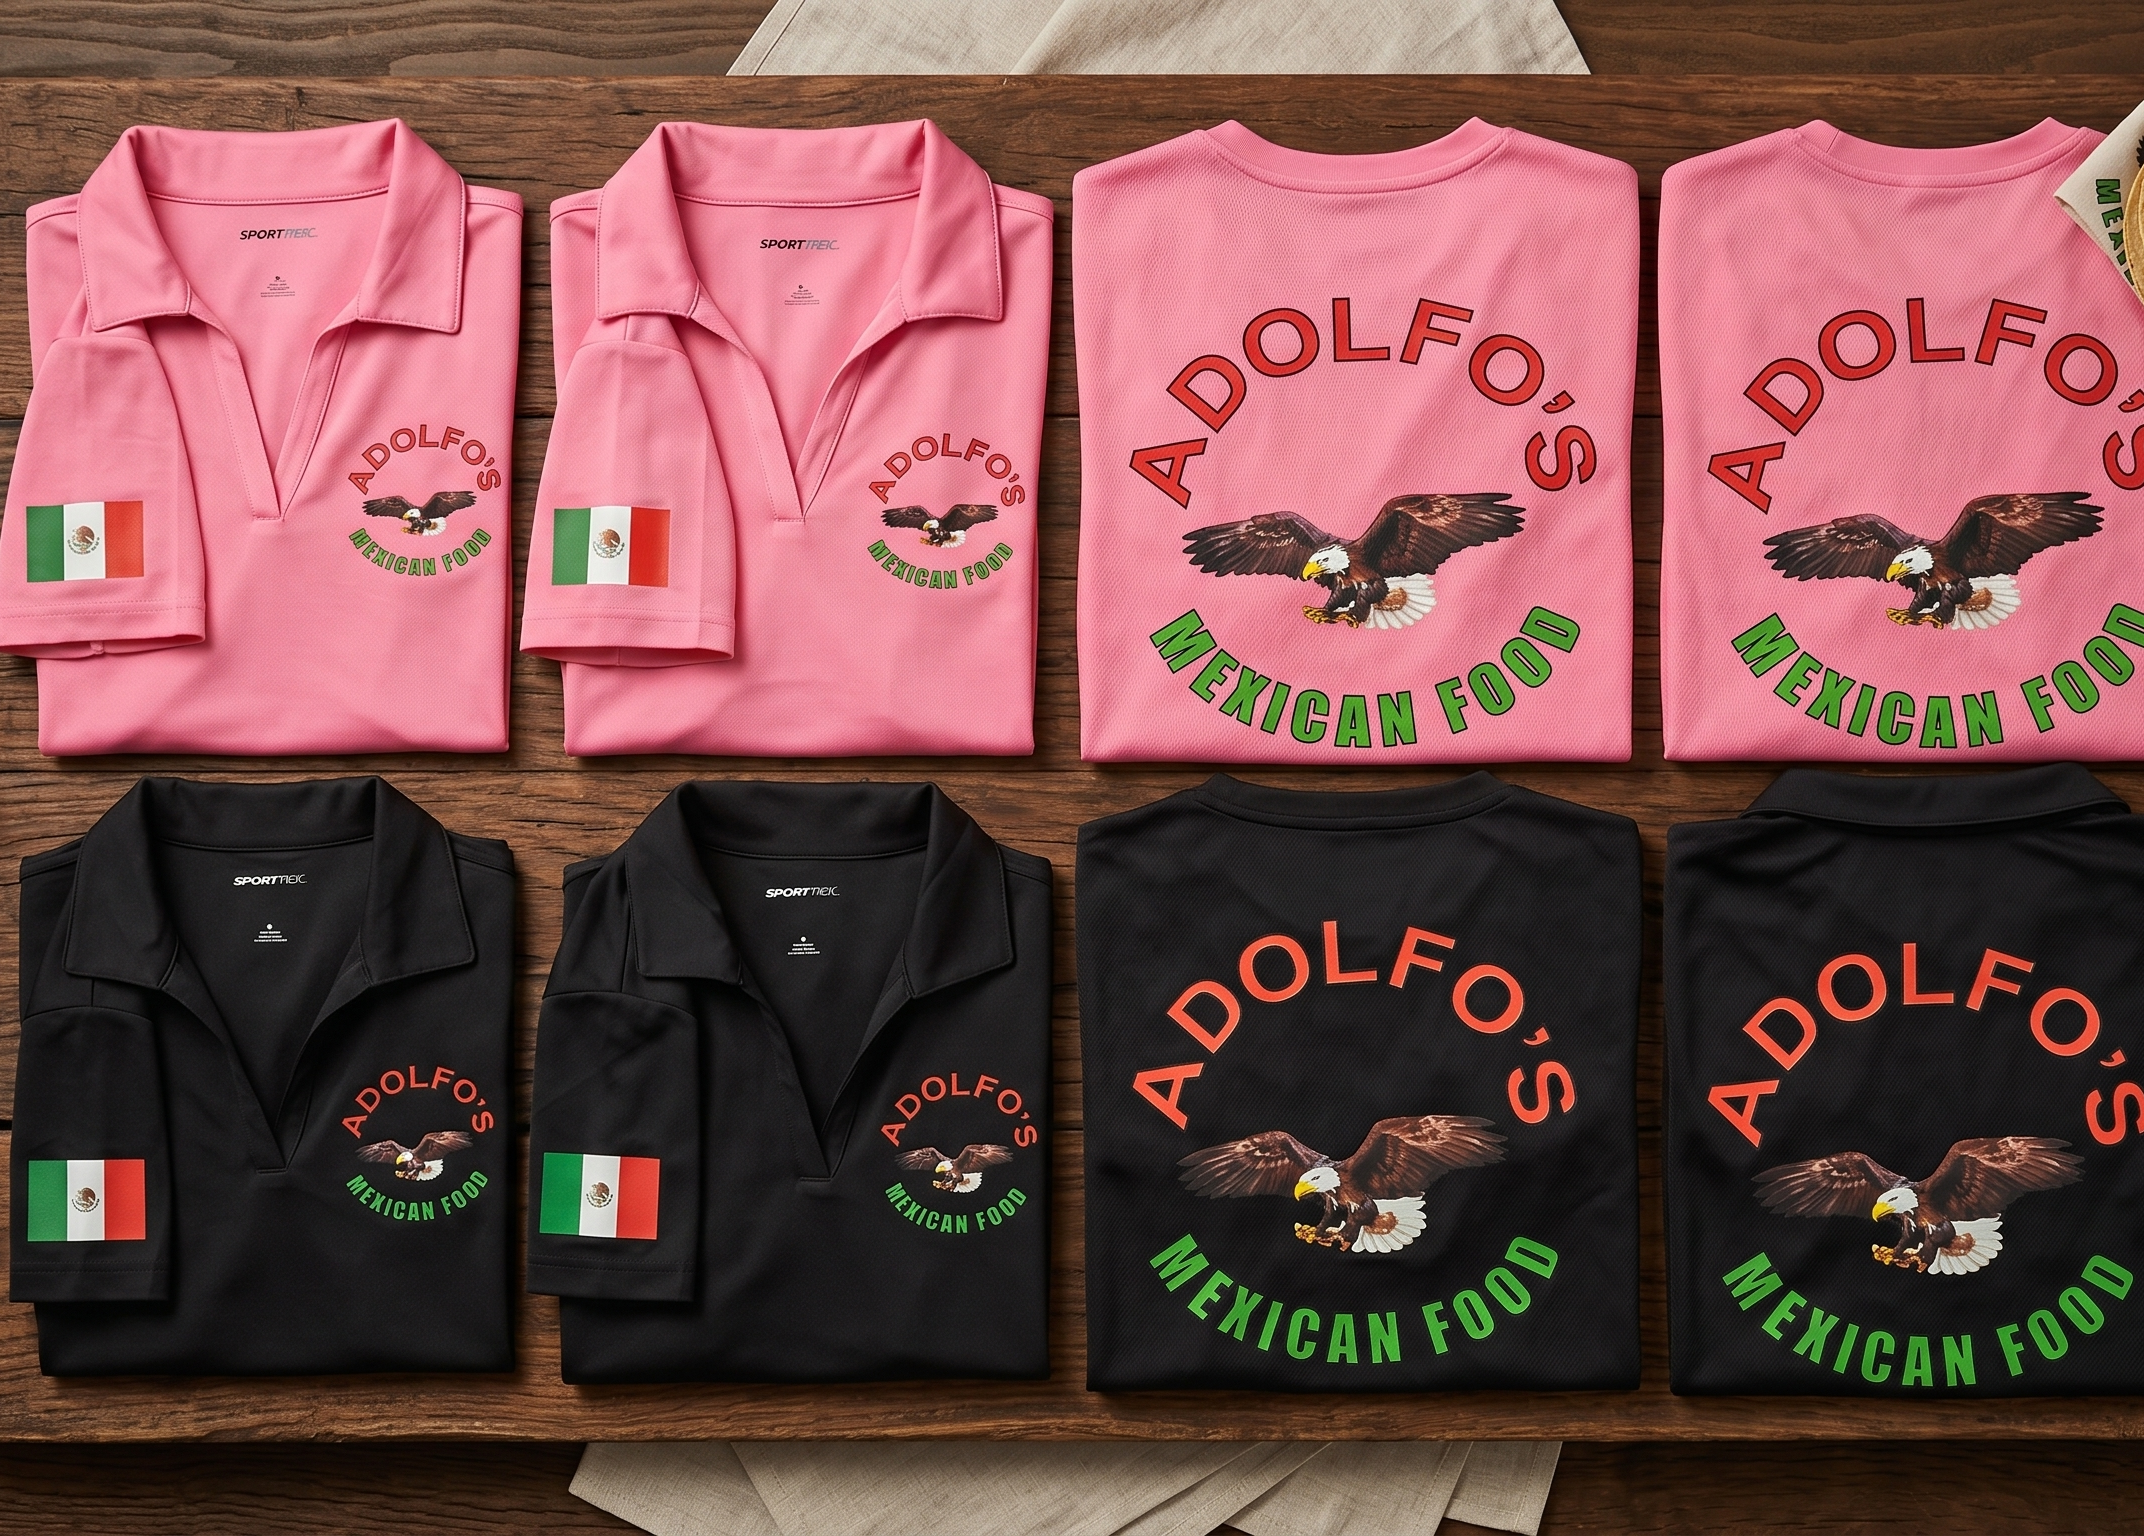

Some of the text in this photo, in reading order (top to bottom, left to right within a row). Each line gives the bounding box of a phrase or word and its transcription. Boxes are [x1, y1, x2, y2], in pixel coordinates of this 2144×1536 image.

[1129, 297, 1597, 509] ADOLFO'S
[348, 424, 501, 495] ADOLFO'S
[869, 433, 1025, 507] ADOLFO'S
[349, 528, 492, 576] MEXICAN FOOD
[867, 539, 1013, 589] MEXICAN FOOD
[1150, 606, 1581, 748] MEXICAN FOOD
[1731, 612, 2004, 749] MEXICAN
[1132, 920, 1576, 1131] ADOLFO'S
[1707, 942, 2144, 1148] ADOLFO'S
[341, 1065, 495, 1139] ADOLFO'S
[880, 1072, 1038, 1147] ADOLFO'S
[346, 1170, 488, 1221] MEXICAN FOOD
[885, 1182, 1027, 1233] MEXICAN FOOD
[1149, 1233, 1559, 1364] MEXICAN FOOD
[1722, 1252, 2135, 1387] MEXICAN FOOD
